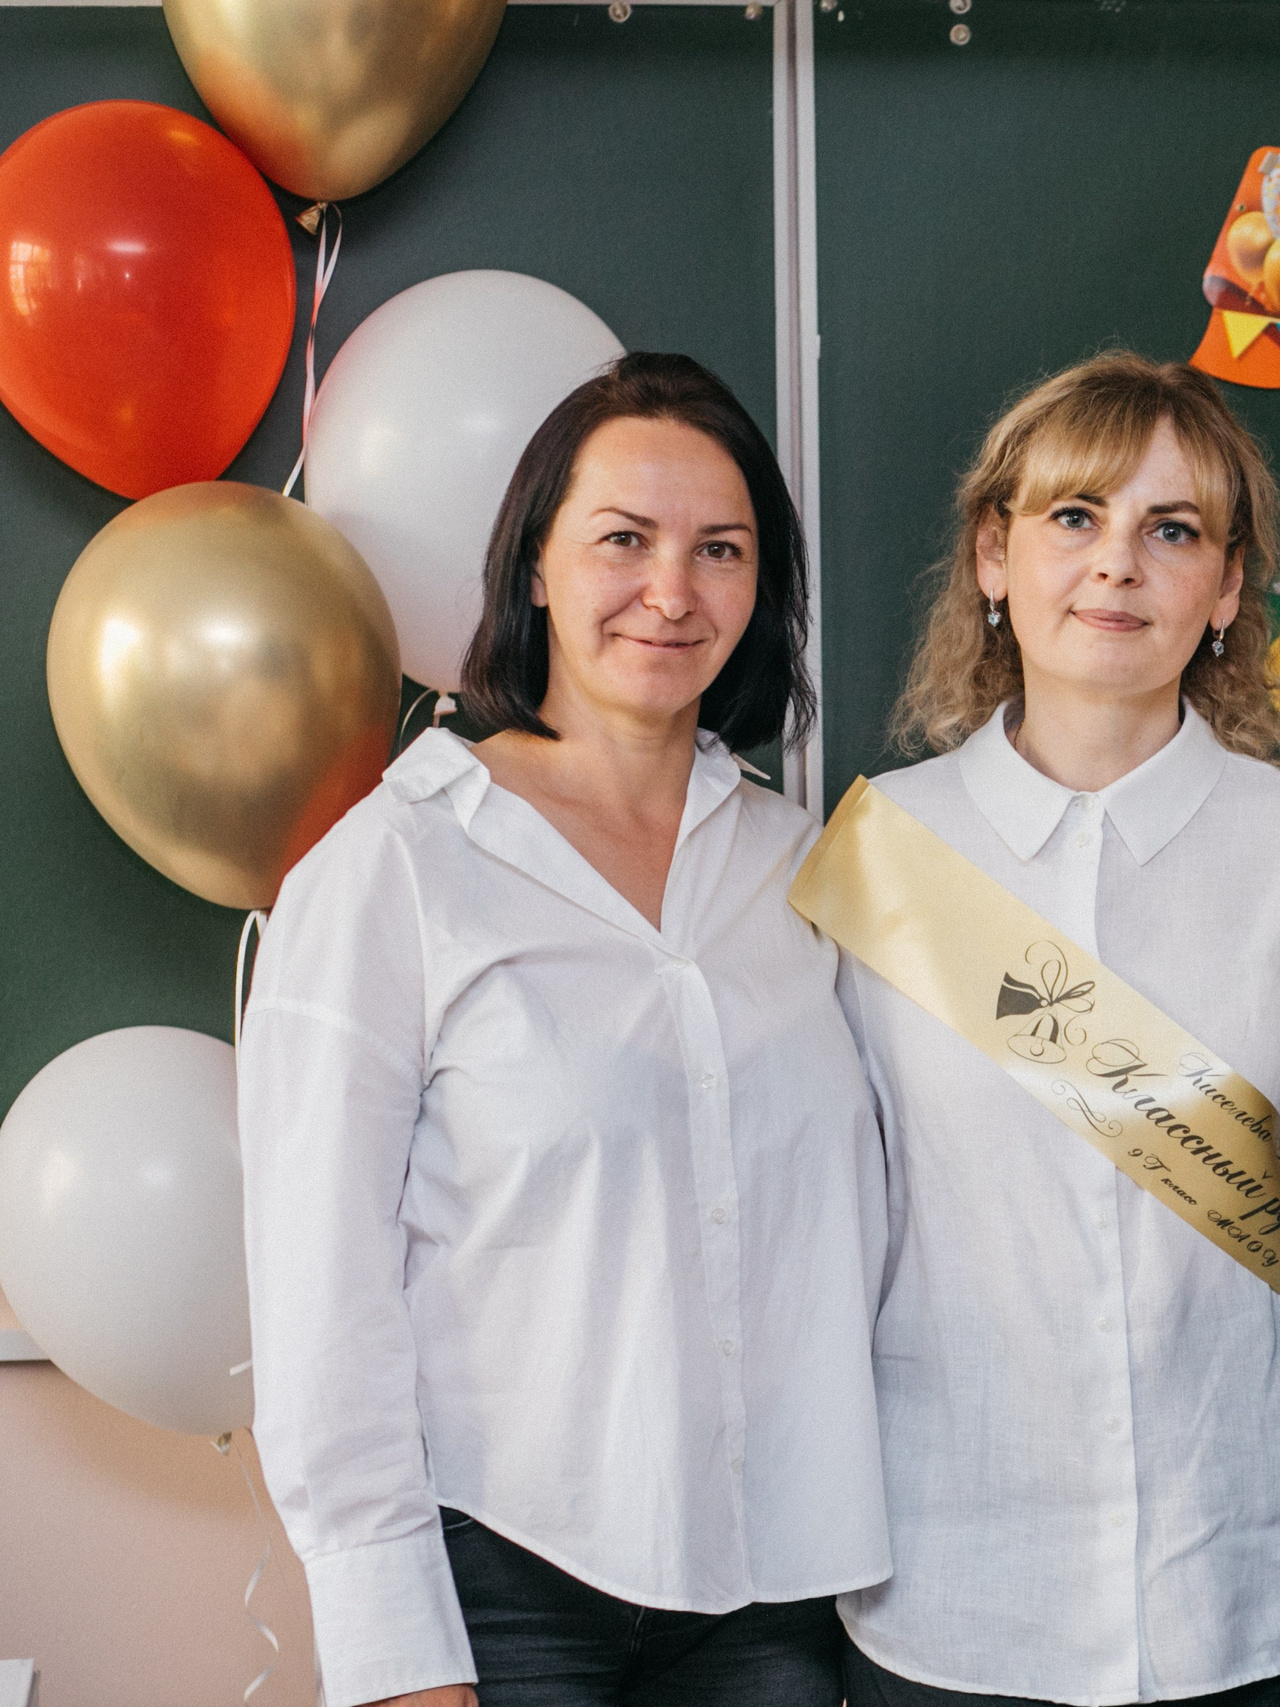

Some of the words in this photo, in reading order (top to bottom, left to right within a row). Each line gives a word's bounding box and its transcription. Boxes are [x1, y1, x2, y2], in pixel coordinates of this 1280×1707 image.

[1086, 1038, 1272, 1198] Классный
[1177, 1052, 1273, 1142] Киселева
[1161, 1178, 1198, 1205] класс
